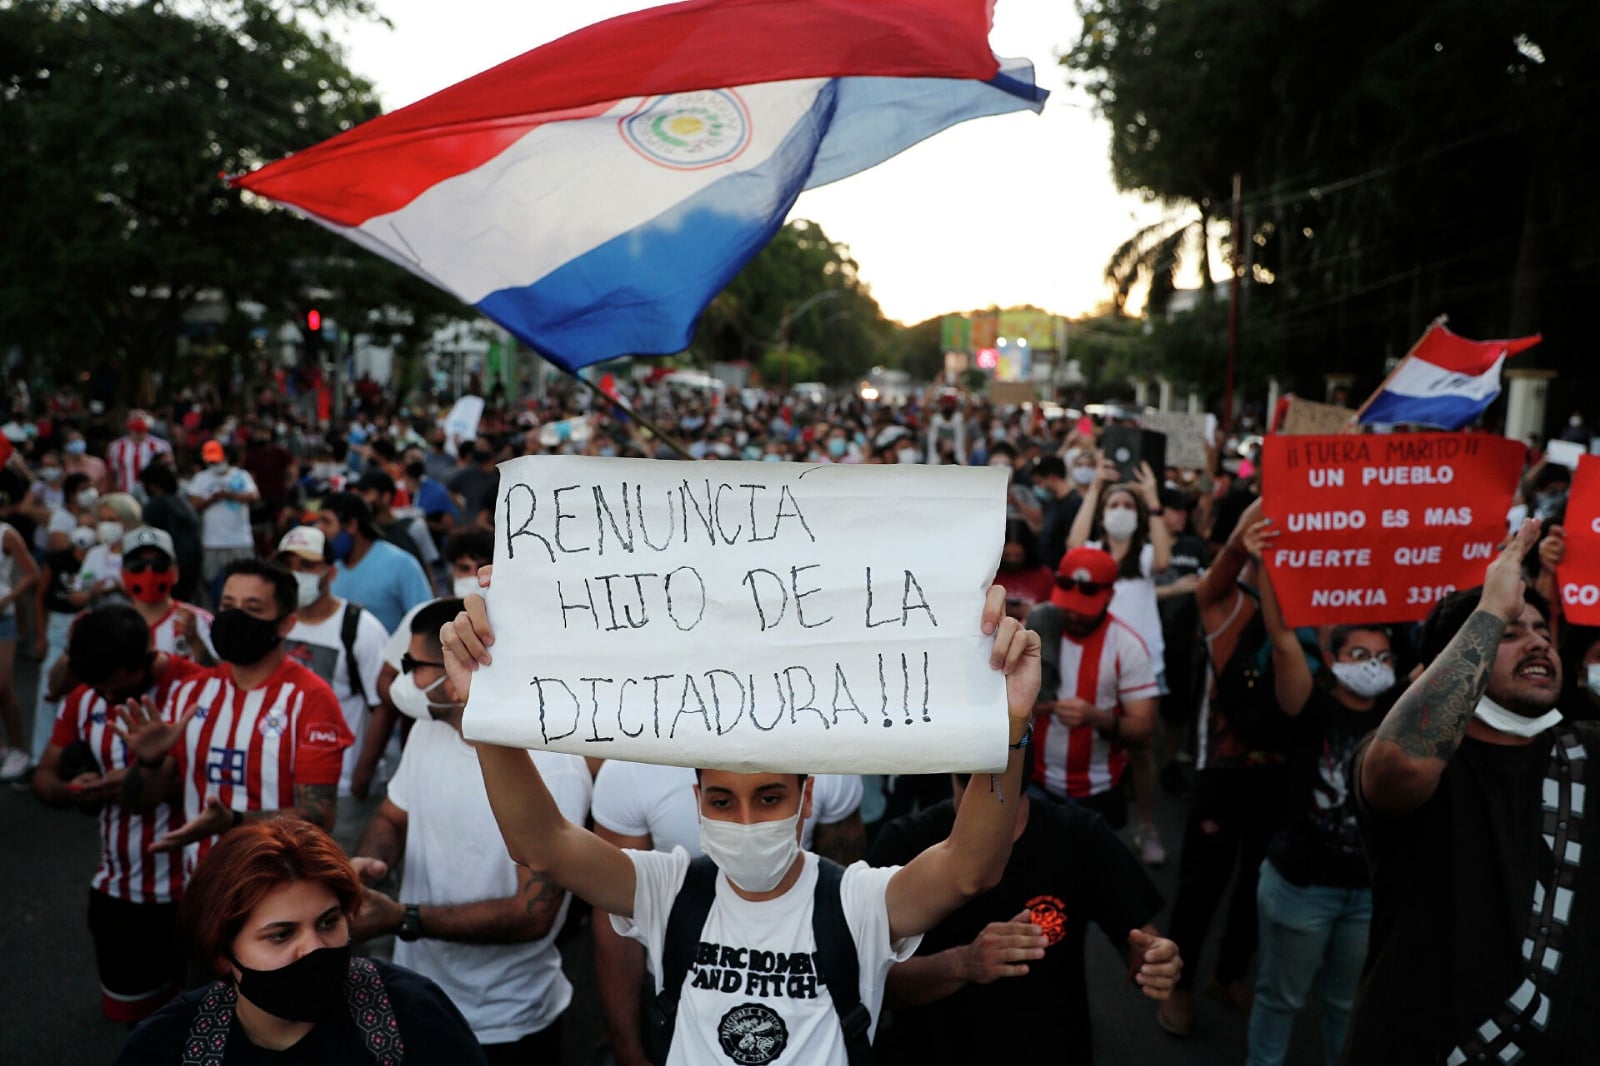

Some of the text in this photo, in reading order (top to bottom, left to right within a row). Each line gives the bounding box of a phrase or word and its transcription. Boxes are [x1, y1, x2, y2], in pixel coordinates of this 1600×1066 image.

[1308, 465, 1454, 488] UN PUEBLO
[504, 478, 816, 562] RENUNCIA
[1288, 506, 1472, 531] UNIDO ES MAS
[1274, 542, 1492, 568] FUERTE QUE UN
[557, 563, 938, 632] HIJO DE LA
[1311, 588, 1388, 607] NOKIA
[530, 651, 932, 745] DICTADURA!!!
[694, 941, 817, 975] BERCROMBI
[691, 968, 818, 999] AND FITCH
